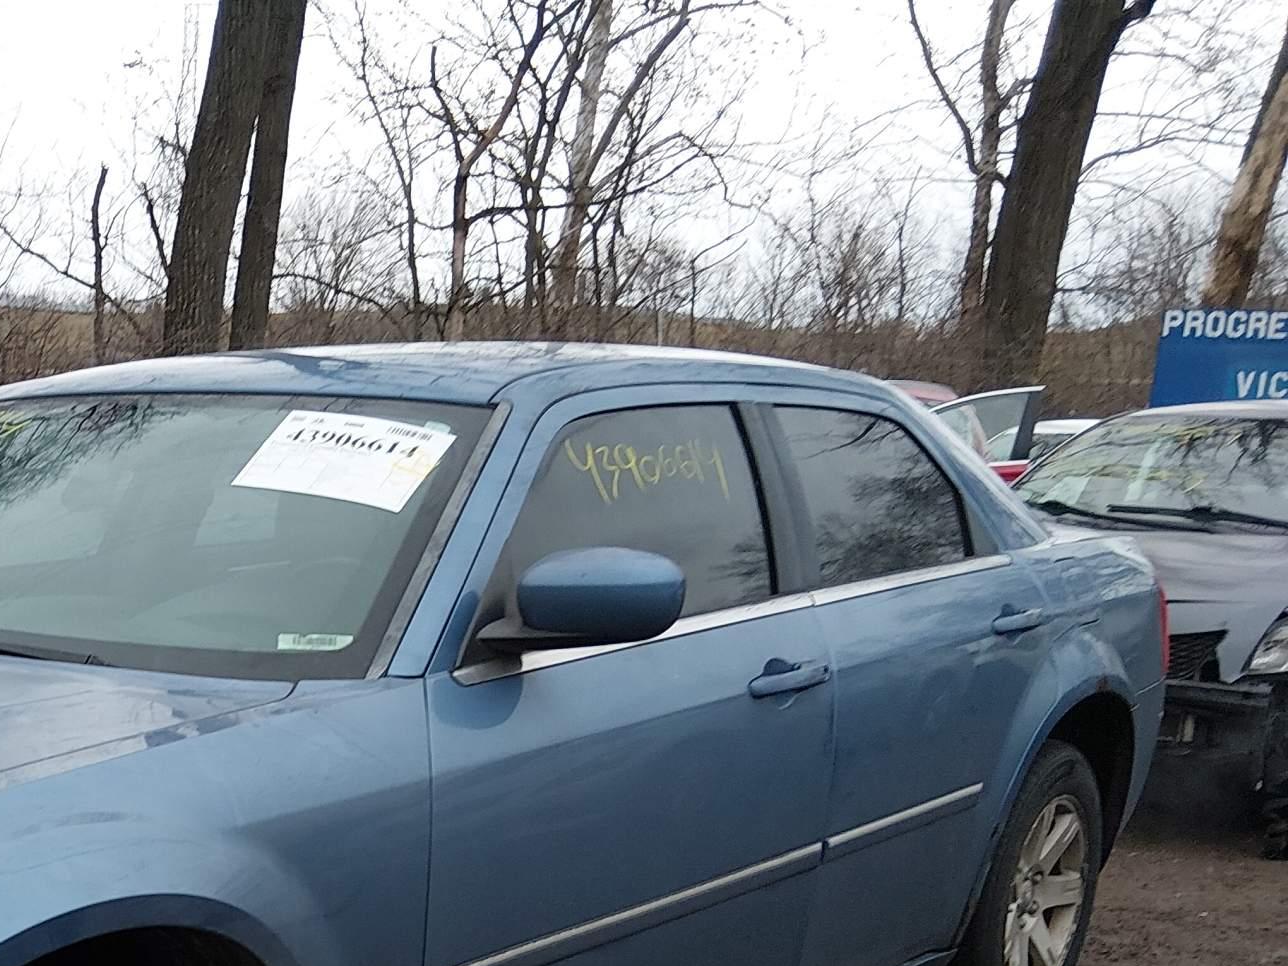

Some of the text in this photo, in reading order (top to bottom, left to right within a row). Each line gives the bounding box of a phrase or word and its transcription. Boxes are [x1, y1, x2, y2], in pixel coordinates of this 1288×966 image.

[1163, 309, 1288, 339] PROGRE
[1237, 371, 1288, 398] VIC
[286, 427, 420, 458] 43906614
